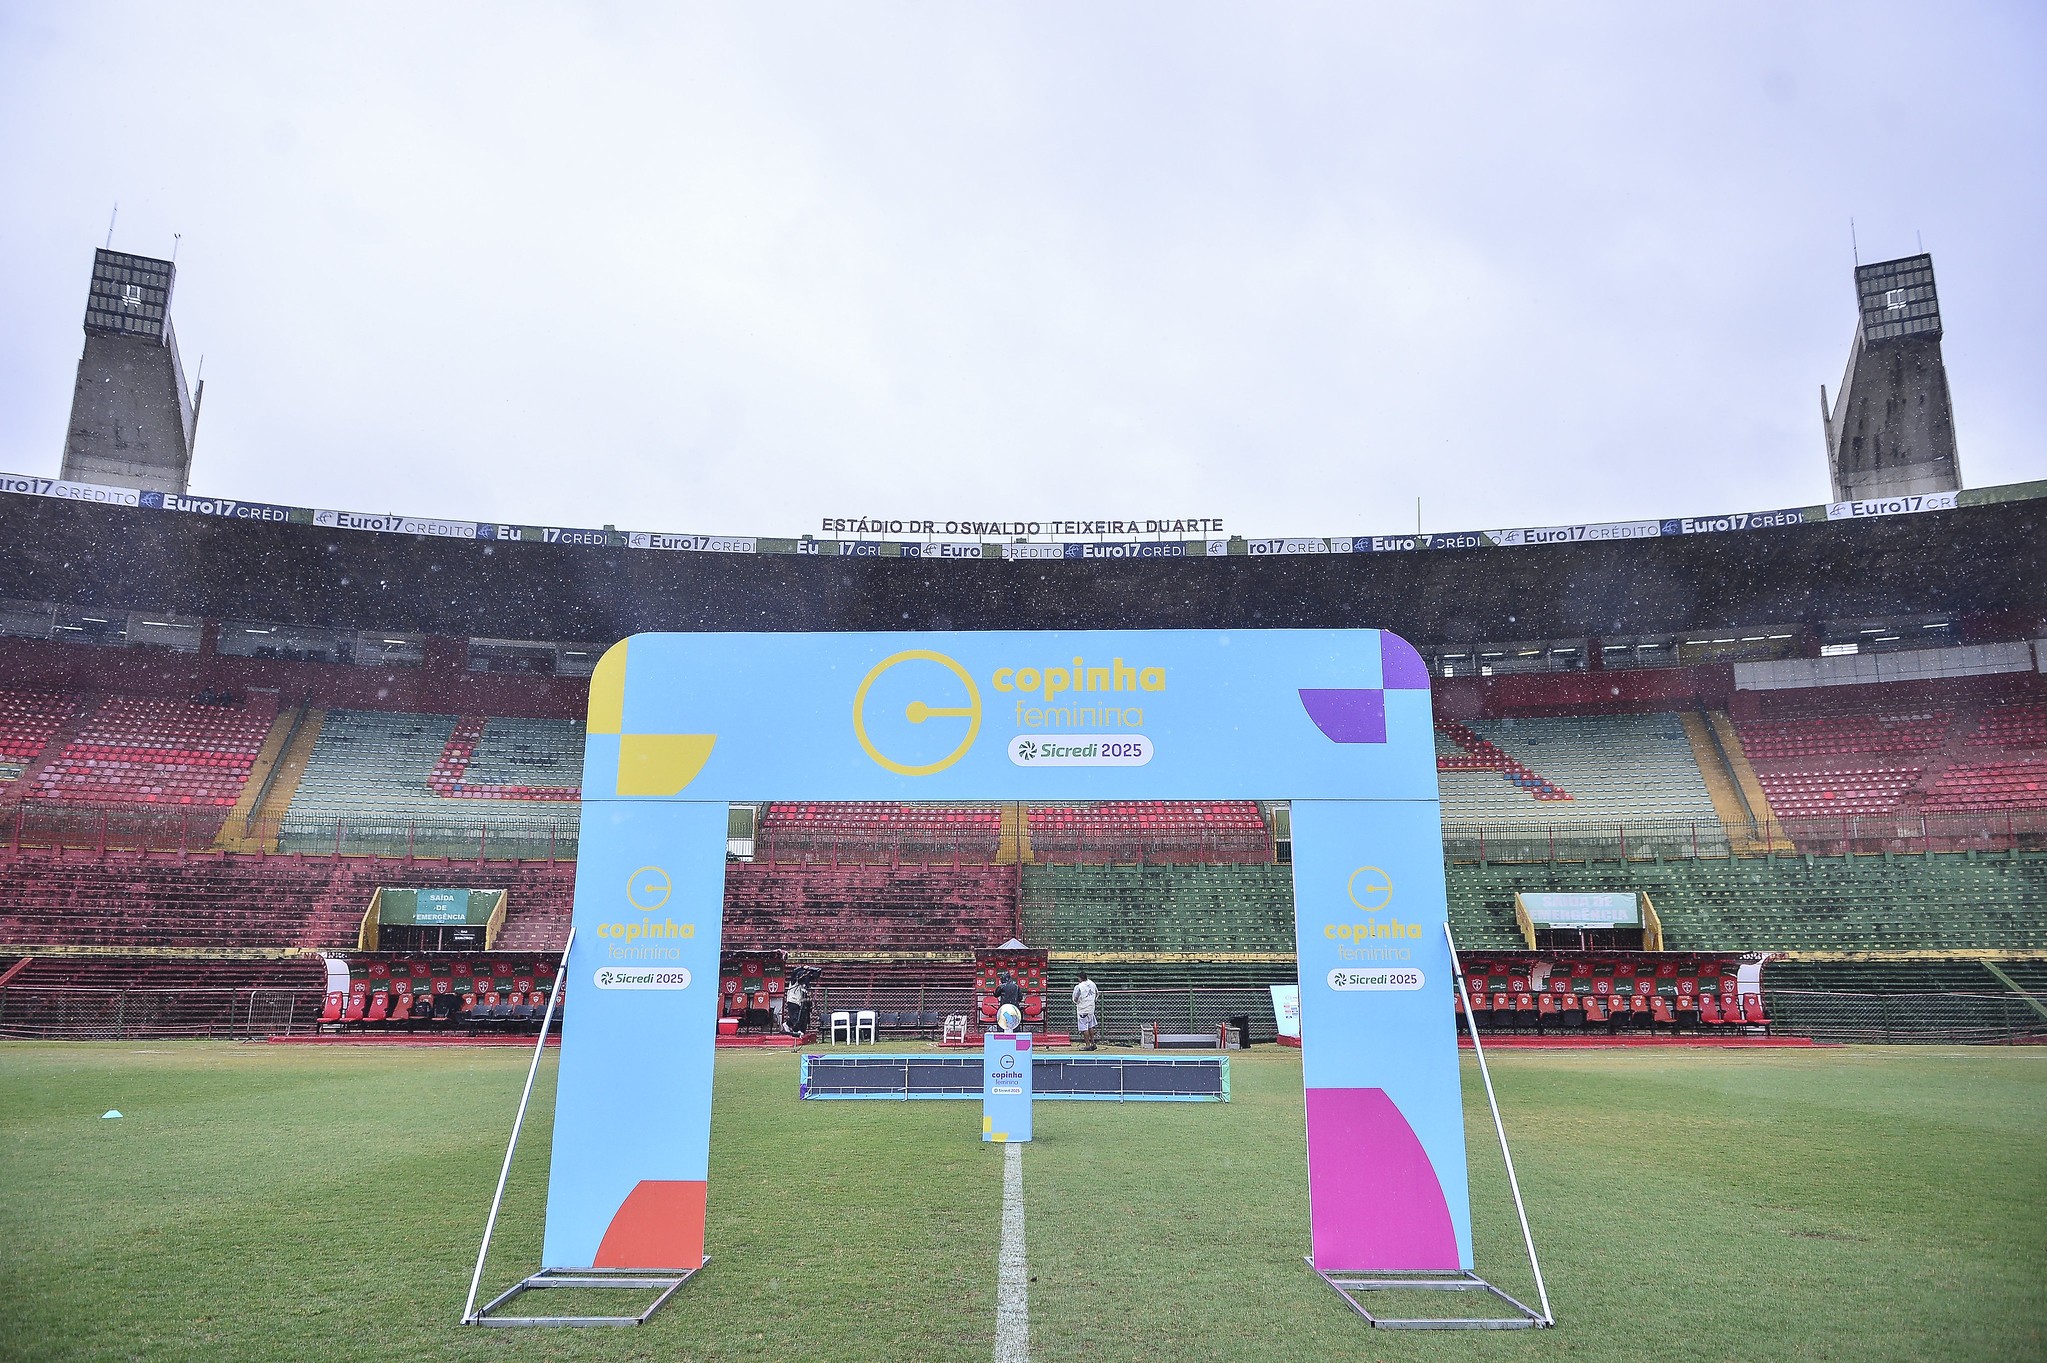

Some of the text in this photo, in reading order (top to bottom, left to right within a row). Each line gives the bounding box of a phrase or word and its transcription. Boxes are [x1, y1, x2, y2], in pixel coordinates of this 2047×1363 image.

[55, 485, 136, 505] CRÉDITO
[162, 493, 290, 522] Euro17 CRÉDI
[1852, 497, 1958, 516] Euro17 CR
[336, 513, 474, 538] Euro17 CRÉDITO
[822, 516, 1224, 536] ESTÁDIO DR. OSWALDO TEIXEIRA DUARTE
[1681, 514, 1749, 534] Euro17
[1523, 525, 1659, 543] Euro17 CRÉDITO
[649, 535, 755, 552] Euro17 CRÉDI
[1083, 544, 1186, 558] Euro17 CRÉDI
[1286, 541, 1351, 554] CRÉDTO
[1372, 535, 1433, 551] Euro7
[1001, 546, 1063, 558] CRÉDITO
[992, 656, 1166, 702] copinha
[1014, 700, 1144, 728] feminina
[1040, 743, 1142, 758] Sicredi 2025
[597, 917, 695, 944] copinha
[1324, 918, 1423, 945] copinha
[609, 943, 681, 960] feminina
[1338, 944, 1411, 961] feminina
[615, 973, 684, 984] Sicredi 2025
[1349, 974, 1418, 985] Sicredi 2025
[991, 1071, 1023, 1079] copinha
